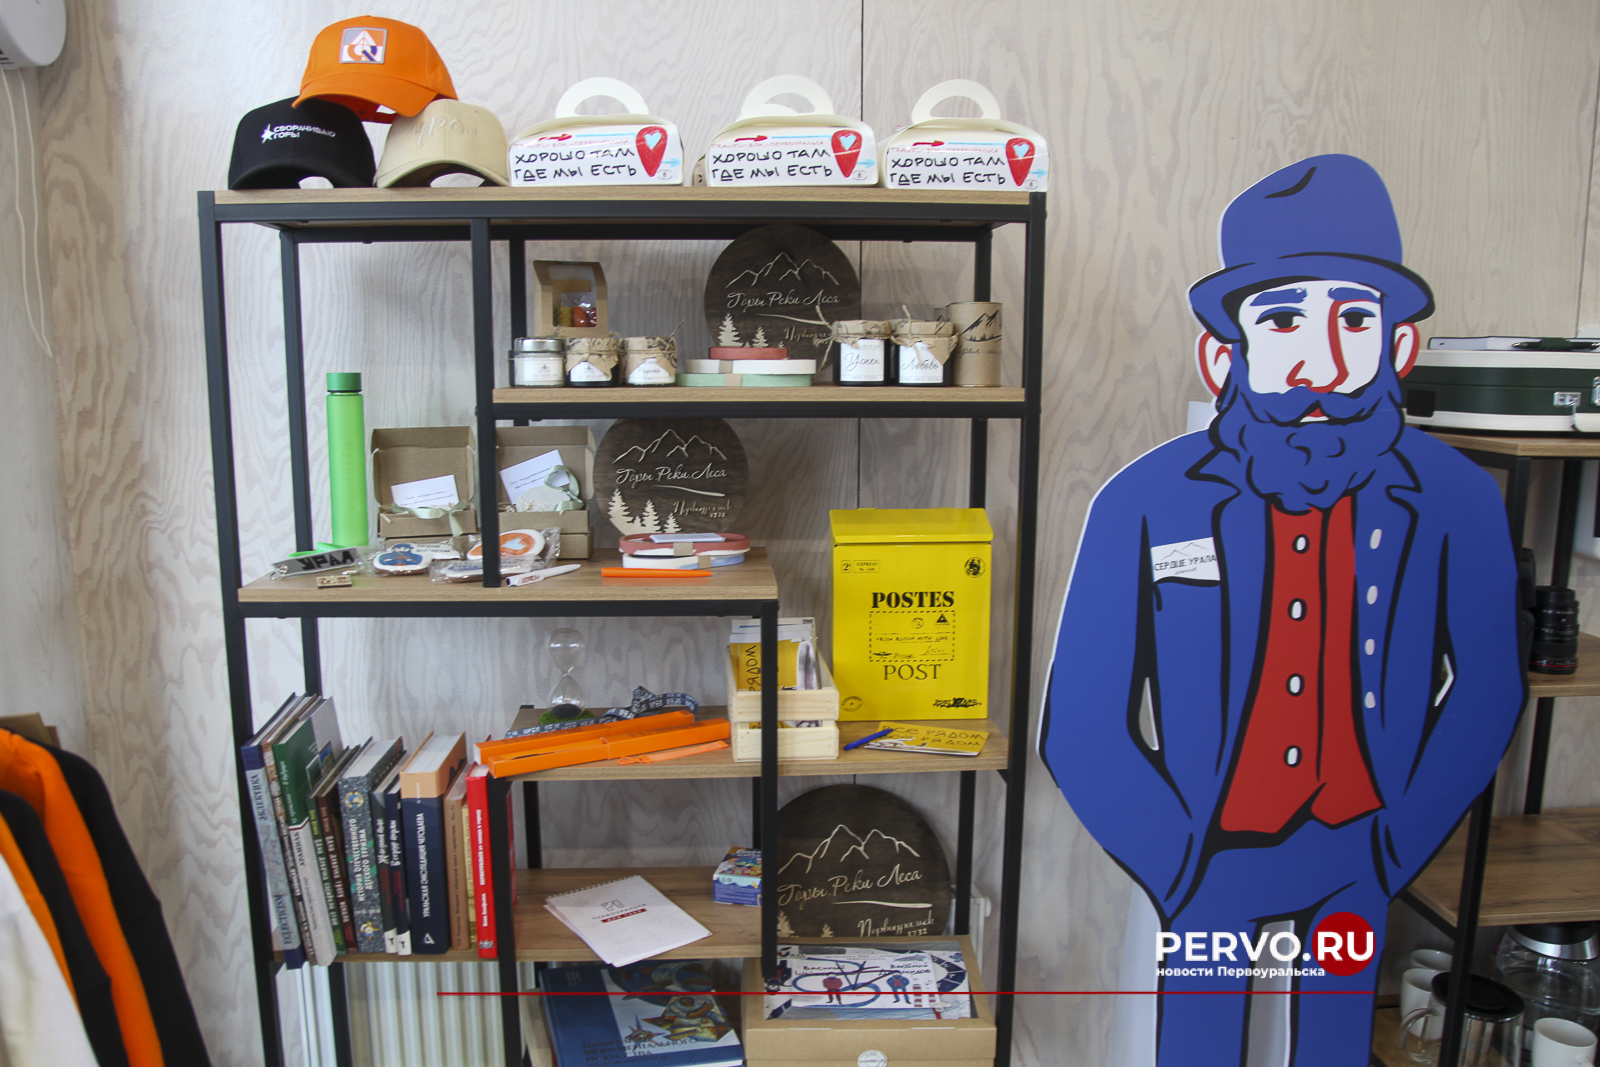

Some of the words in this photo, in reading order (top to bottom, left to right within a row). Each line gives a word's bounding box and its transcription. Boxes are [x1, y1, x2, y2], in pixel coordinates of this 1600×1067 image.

[273, 124, 336, 137] СВОРАЧИВАЮ
[273, 131, 300, 139] ГОРЫ
[515, 150, 585, 164] ХОРОШО
[590, 147, 636, 158] ТАМ
[713, 150, 782, 164] ХОРОШО
[787, 148, 831, 158] ТАМ
[891, 157, 959, 168] ХОРОШО
[963, 156, 1005, 166] ТАМ
[514, 168, 547, 181] ГДЕ
[553, 166, 583, 179] МЫ
[590, 164, 637, 176] ЕСТЬ
[712, 168, 744, 181] ГДЕ
[750, 166, 780, 179] МЫ
[787, 165, 832, 177] ЕСТЬ
[890, 173, 922, 185] ГДЕ
[926, 173, 955, 184] МЫ
[962, 171, 1006, 185] ЕСТЬ
[803, 289, 840, 305] Леса
[690, 462, 728, 479] Леса
[1154, 558, 1187, 572] СЕРДЦЕ
[1189, 554, 1217, 565] УРАЛА
[871, 591, 954, 608] POSTES
[883, 664, 941, 680] POST
[249, 773, 268, 821] ЭКЛЕКТИКА
[415, 812, 425, 847] ЧЕГОДАЕВА
[348, 818, 364, 871] ОТЕЧЕСТВЕННОГО
[359, 828, 369, 858] ТУРИЗМА
[362, 858, 374, 890] ДЕТСКОГО
[418, 846, 430, 885] ЭКСПЕДИЦИЯ
[477, 851, 485, 885] ПЕРВОУРАЛЬСК
[877, 863, 923, 885] Леса
[355, 871, 367, 902] ИСТОРИЯ
[420, 884, 431, 918] УРАЛЬСКАЯ
